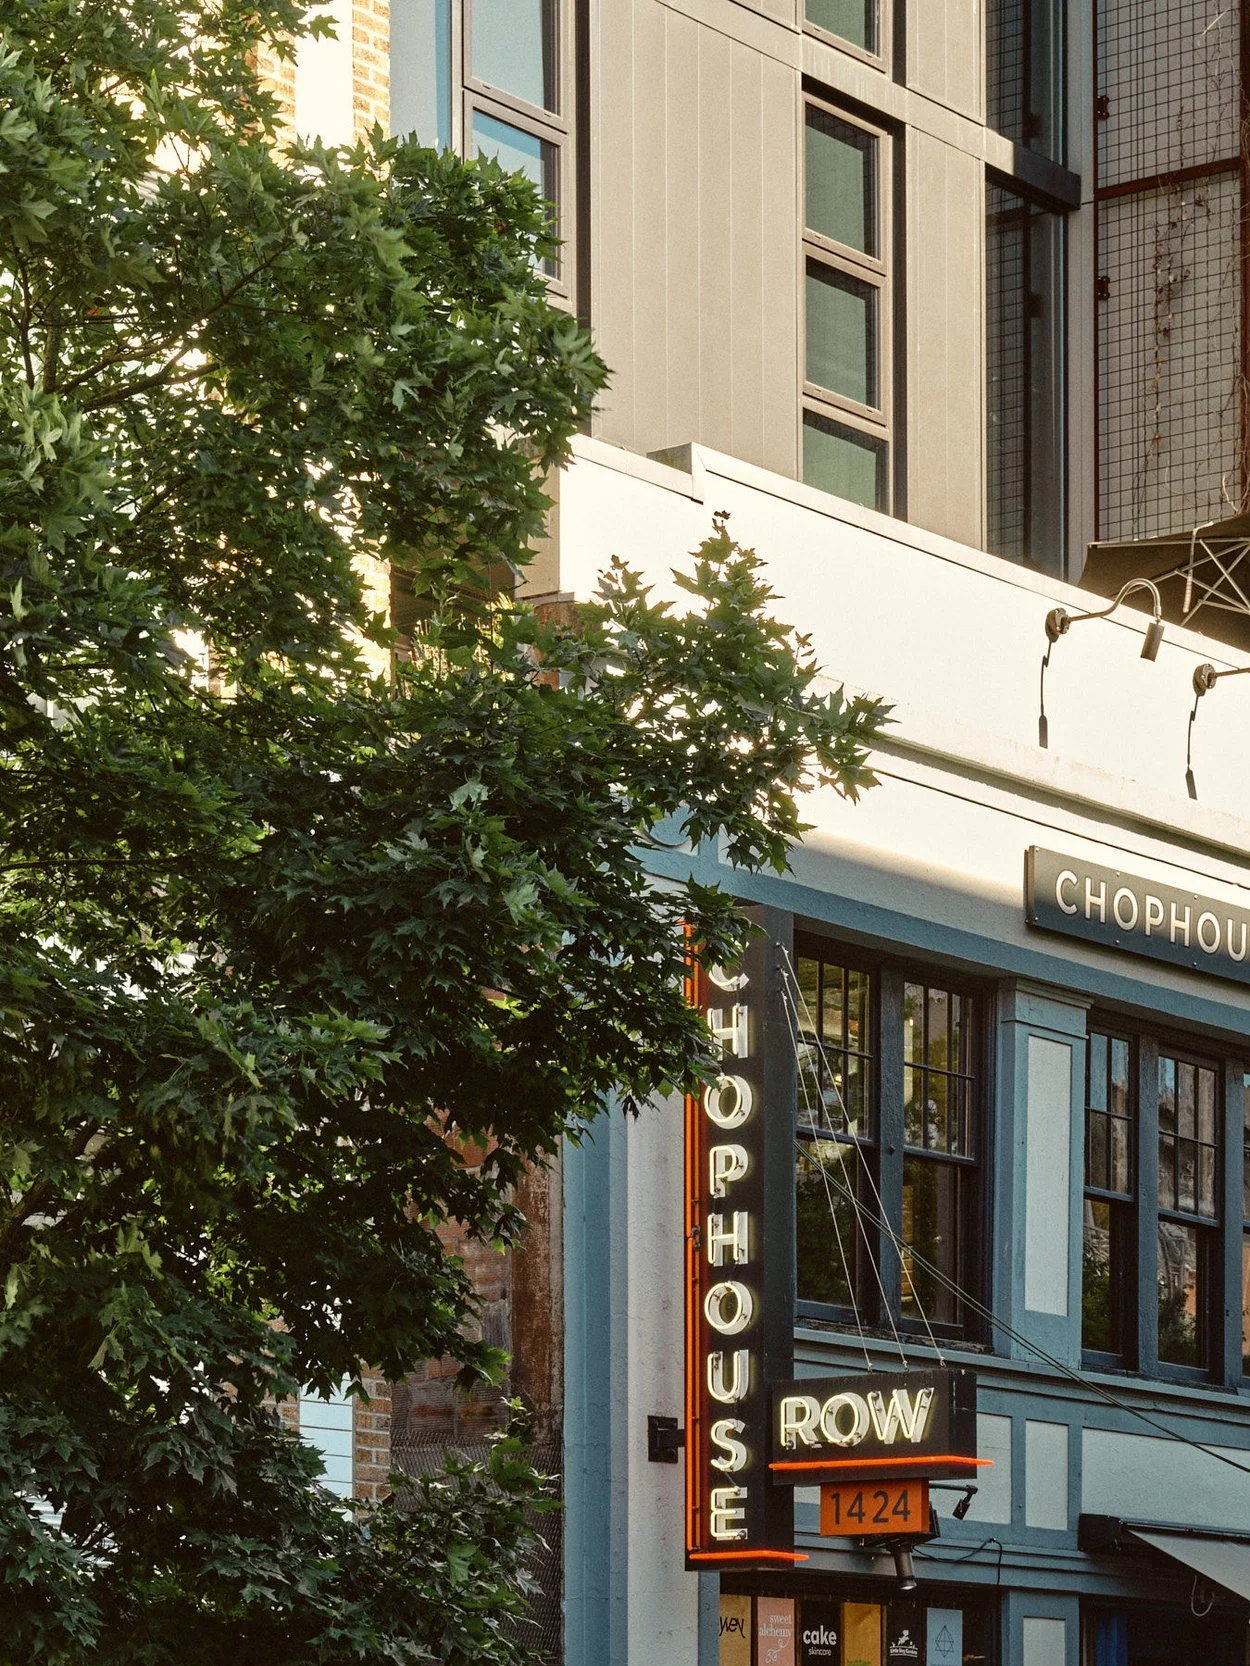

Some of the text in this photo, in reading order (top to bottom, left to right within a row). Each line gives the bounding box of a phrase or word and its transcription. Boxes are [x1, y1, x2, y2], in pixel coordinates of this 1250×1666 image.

[780, 1387, 934, 1450] ROW
[830, 1489, 911, 1525] 1424
[770, 1614, 793, 1625] sweet
[759, 1623, 792, 1639] alchemy
[803, 1625, 837, 1645] cake
[808, 1647, 832, 1656] skincare
